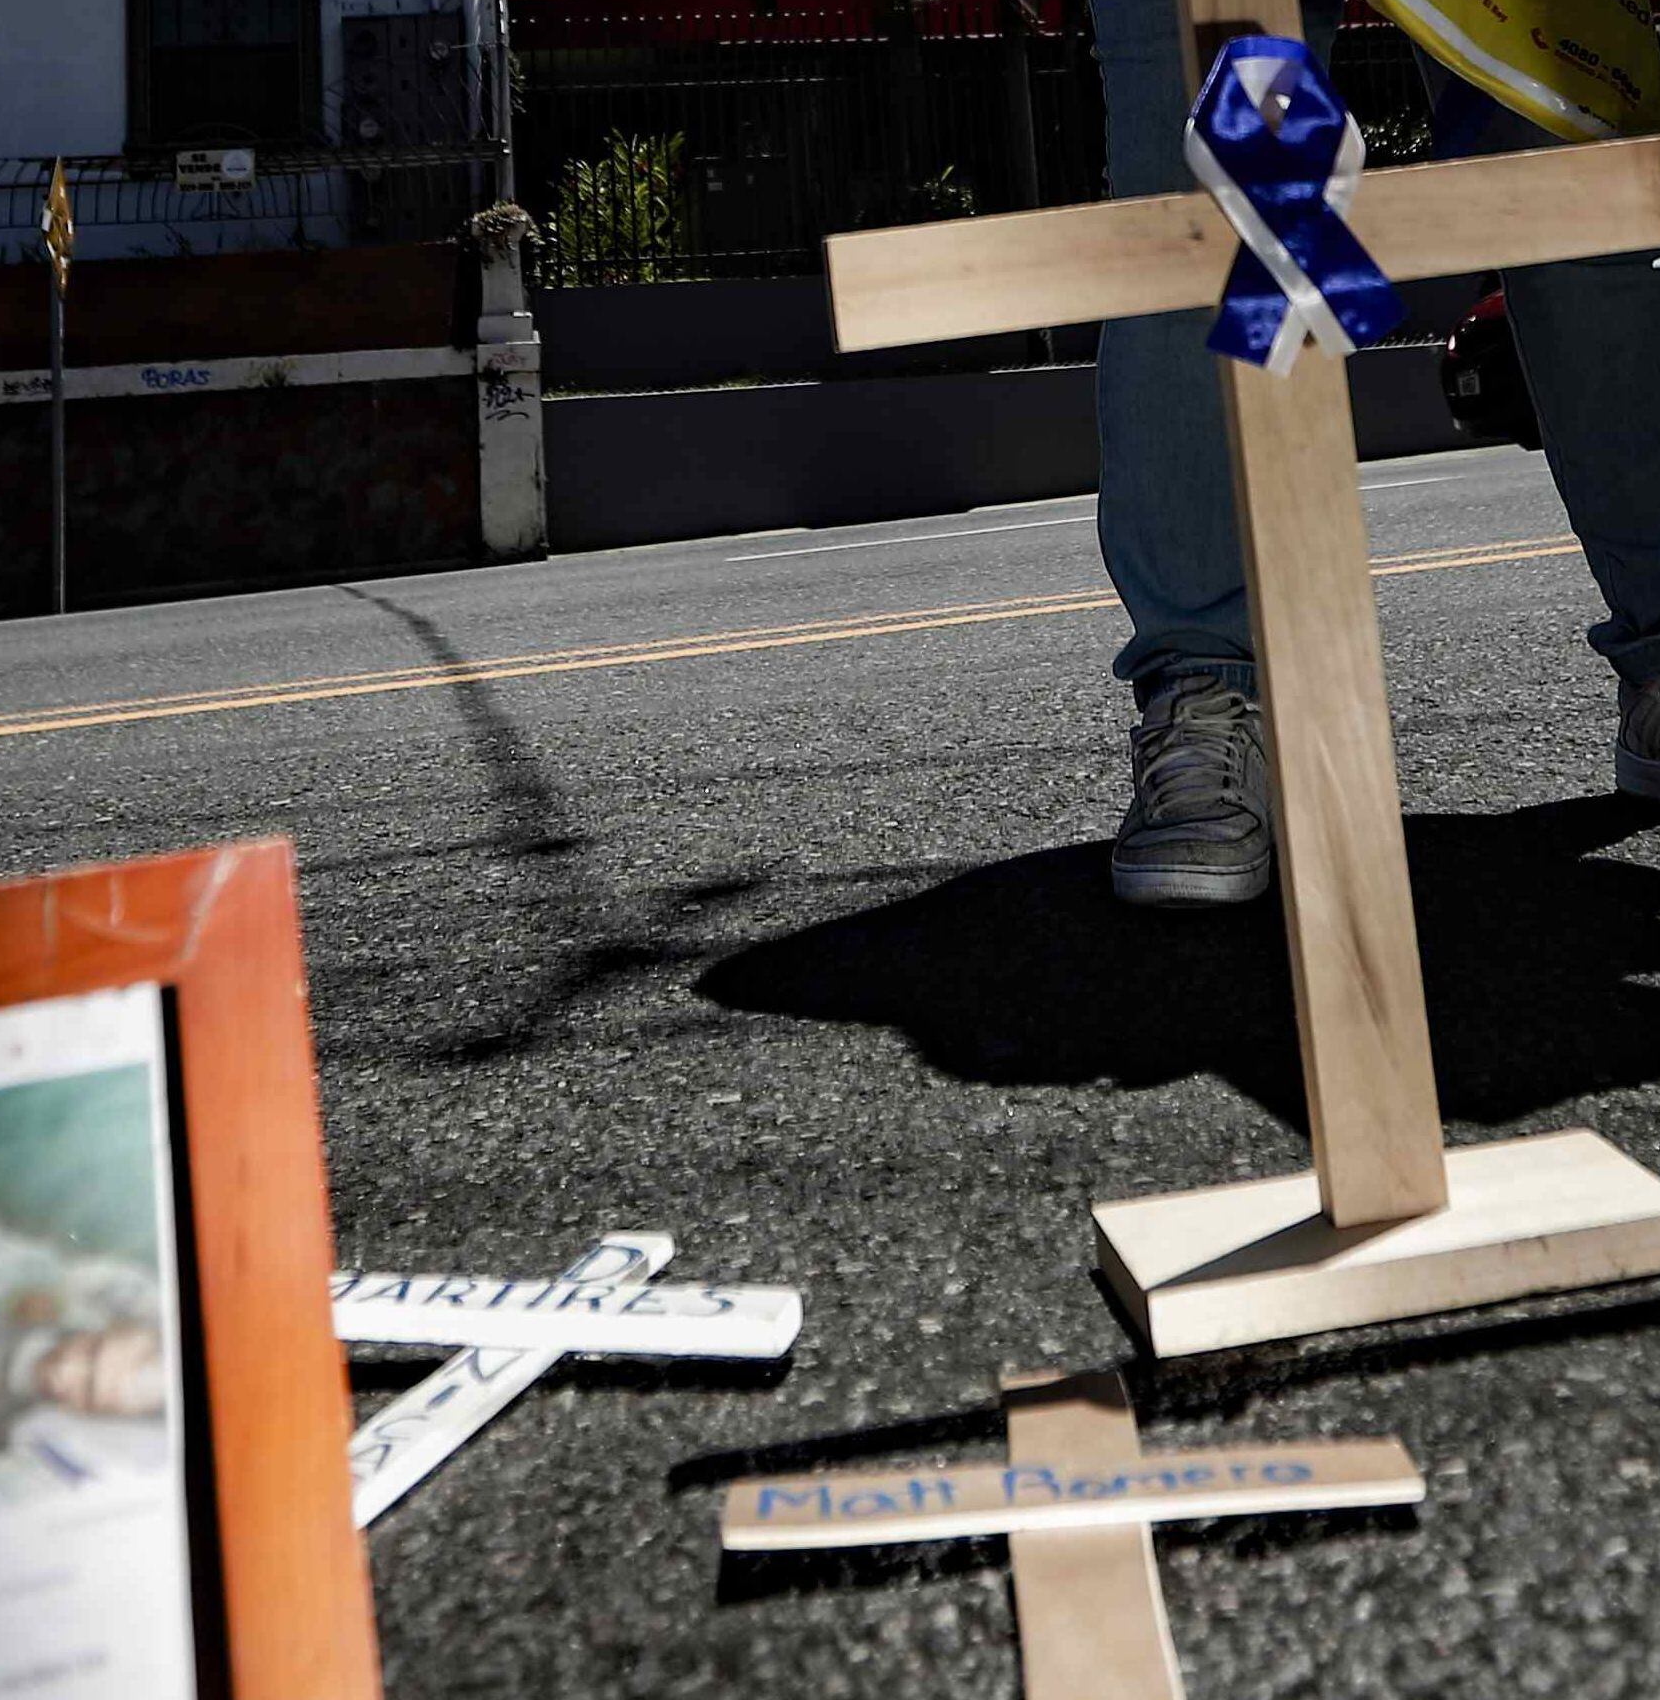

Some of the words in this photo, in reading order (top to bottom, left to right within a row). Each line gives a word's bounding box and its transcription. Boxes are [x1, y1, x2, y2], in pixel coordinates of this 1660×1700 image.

[1559, 38, 1600, 67] 4080
[191, 153, 207, 163] SE
[178, 163, 222, 174] VENDE
[755, 1475, 956, 1522] Matt
[1000, 1460, 1315, 1502] Romero
